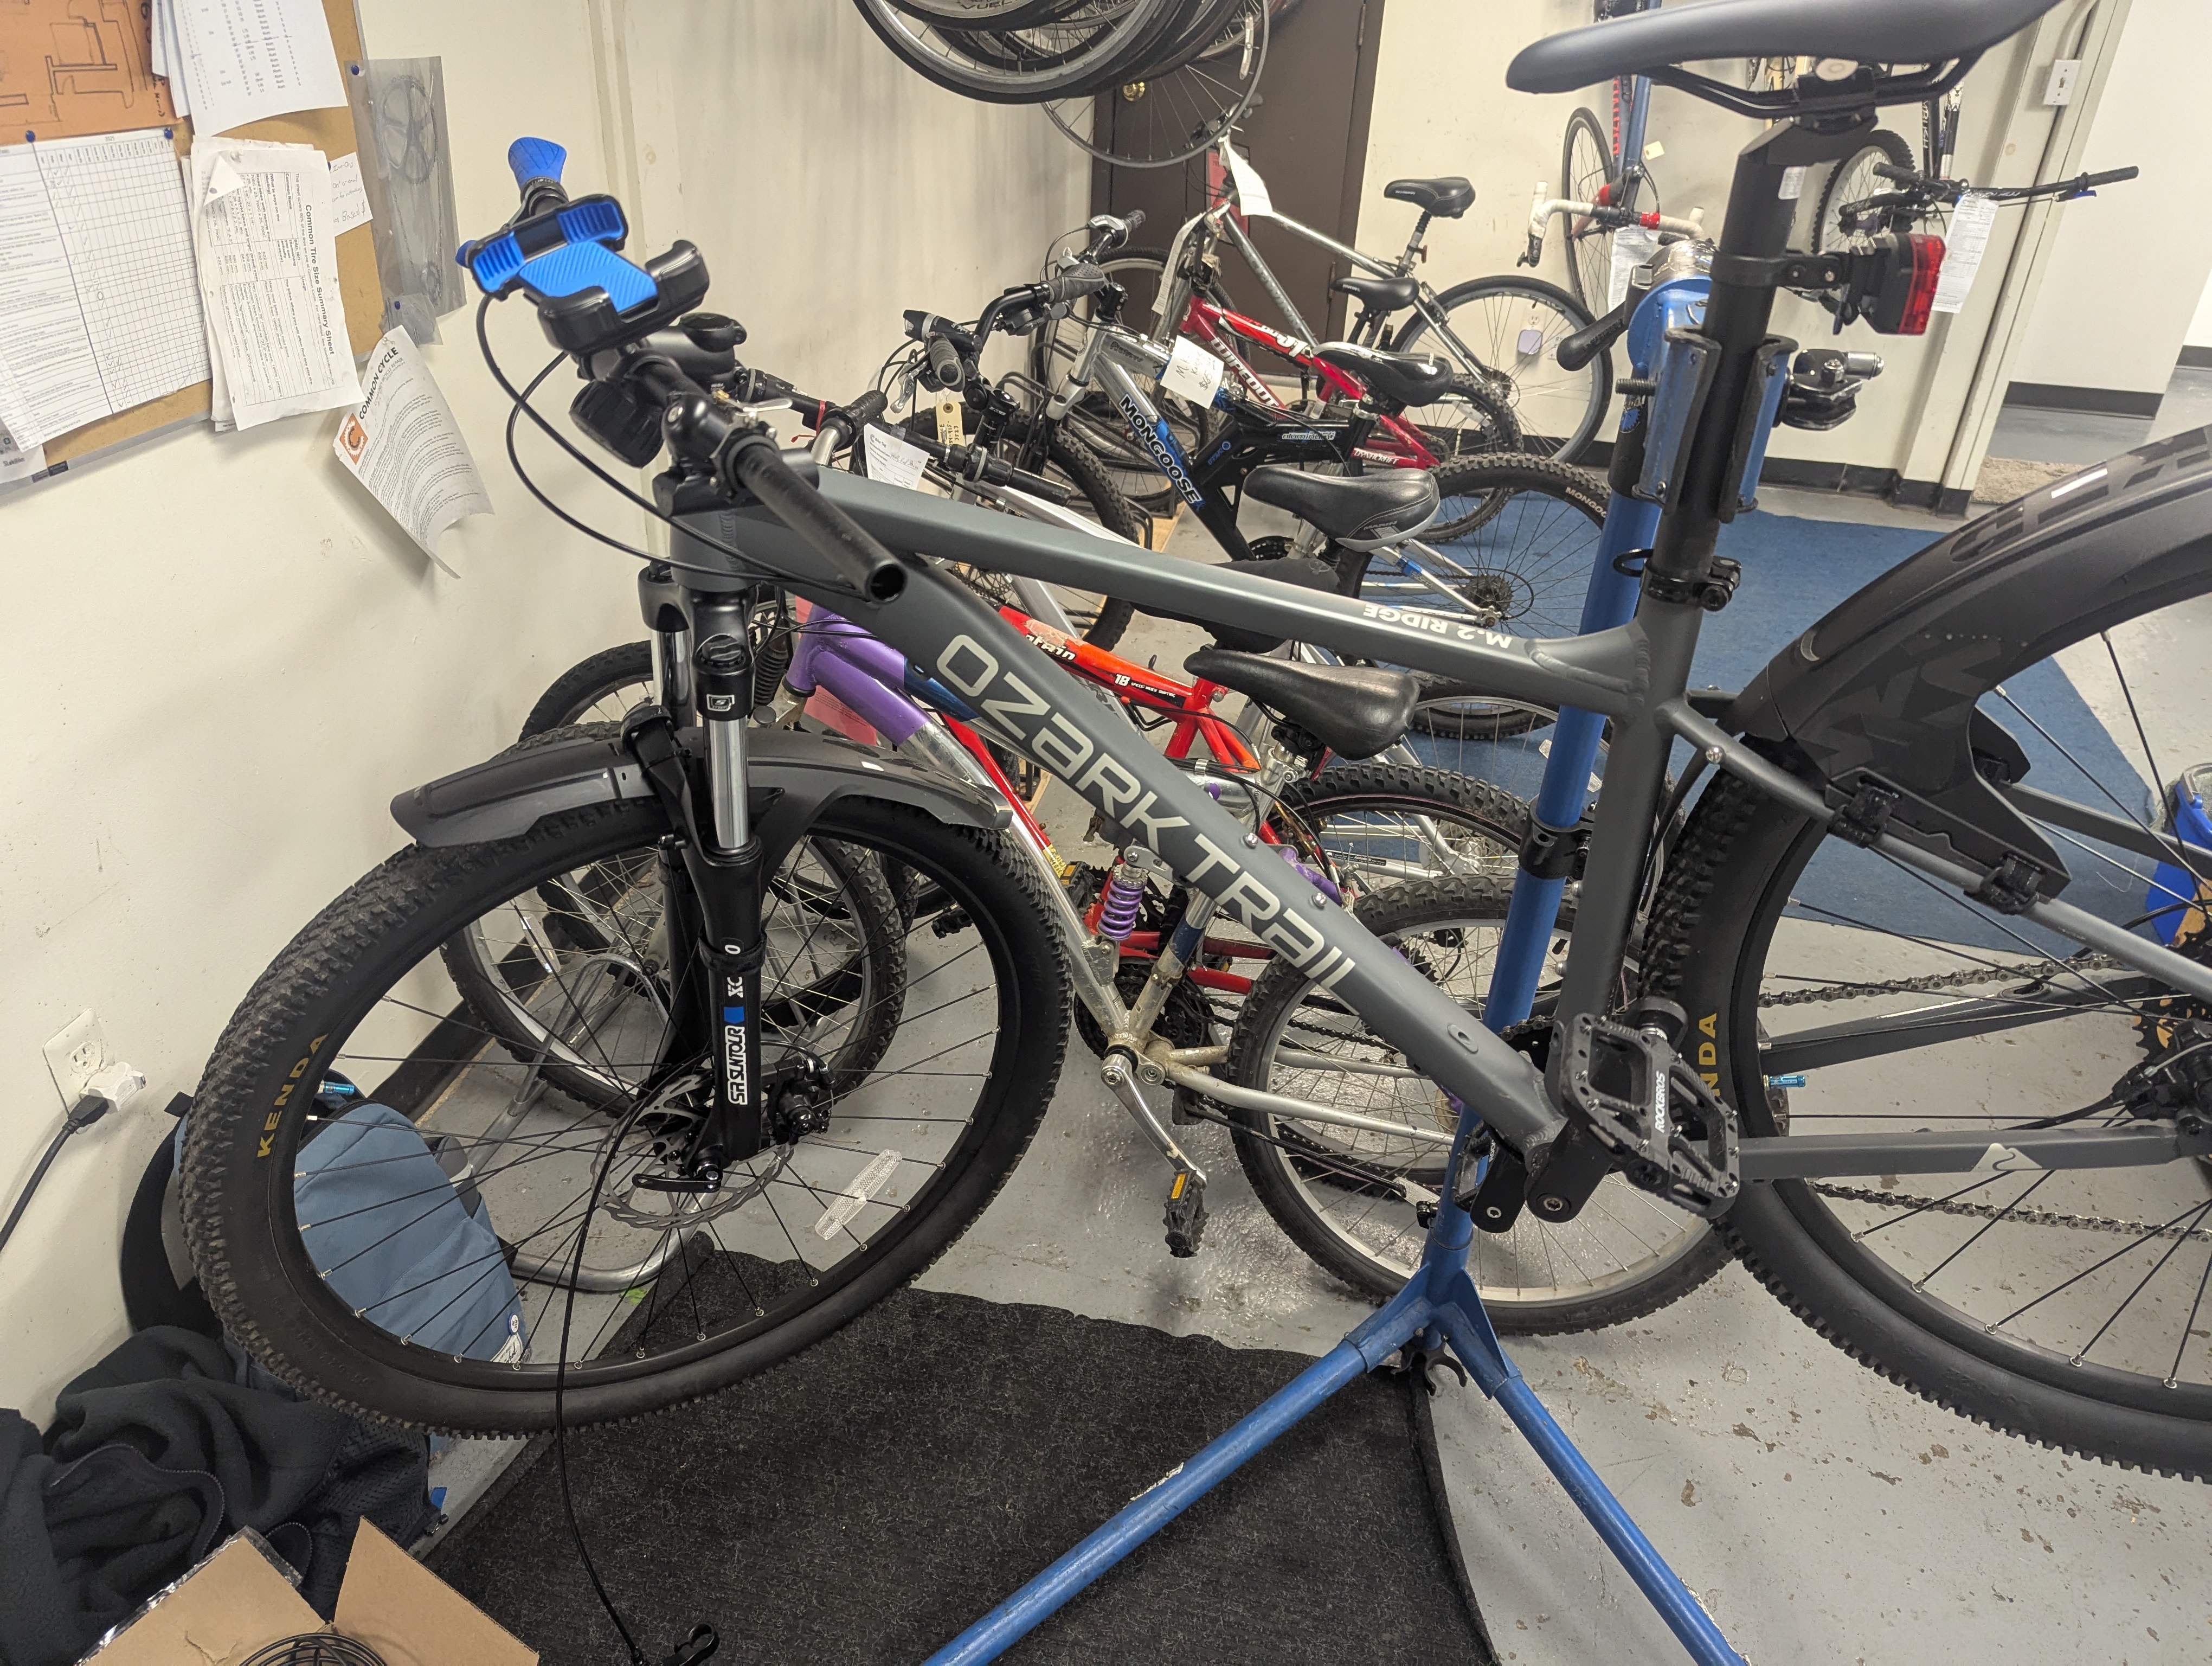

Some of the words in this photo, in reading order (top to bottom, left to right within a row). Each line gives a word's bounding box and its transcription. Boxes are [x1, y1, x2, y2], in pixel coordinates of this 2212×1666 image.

[283, 172, 292, 195] Common
[303, 204, 318, 245] Common
[309, 246, 319, 264] Tire
[312, 266, 321, 285] Size
[316, 286, 329, 328] Summary
[325, 329, 335, 355] Sheet
[352, 373, 385, 420] COMMON
[375, 344, 400, 376] CYCLE
[381, 366, 393, 383] BICYCLE
[390, 354, 404, 370] REPAIR
[1196, 368, 1214, 392] $65
[1208, 330, 1279, 416] WIPEOUT
[1115, 390, 1203, 510] MONGOOSE
[1353, 449, 1400, 465] DYNACRAFT
[1362, 603, 1449, 635] RIDGE
[1457, 625, 1513, 649] M.2
[1114, 673, 1131, 688] 18
[727, 976, 744, 998] XC
[724, 1025, 746, 1080] SUNTOUR
[257, 1033, 330, 1157] KENDA
[727, 1080, 748, 1105] SR
[1655, 1070, 1667, 1133] ROCKBROS
